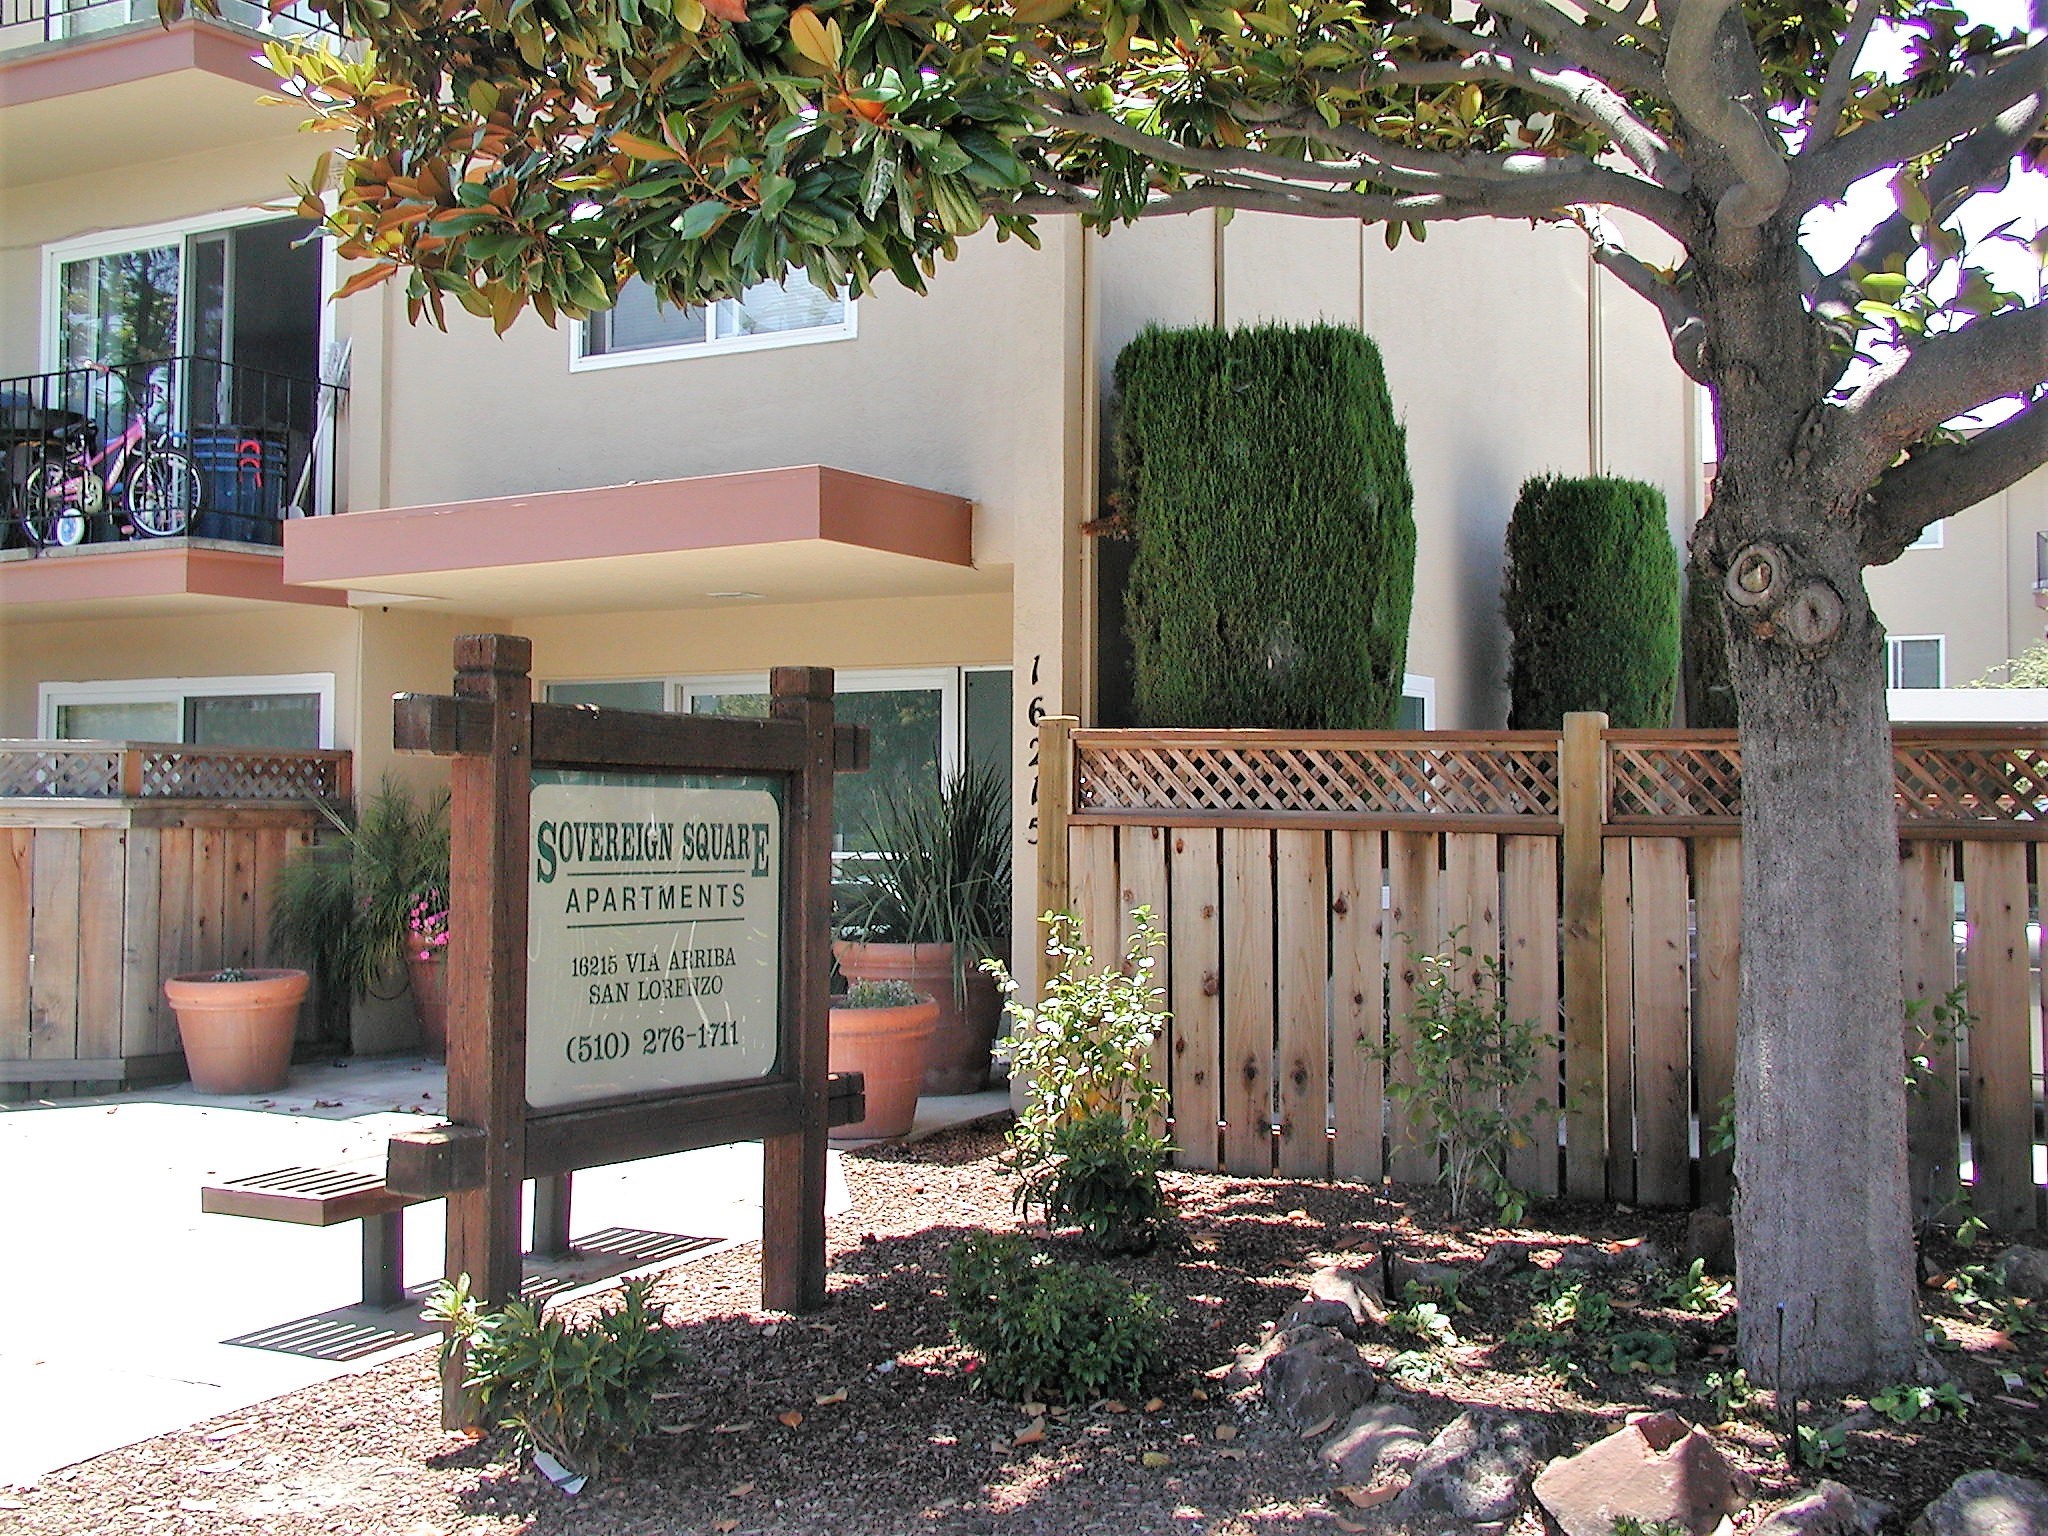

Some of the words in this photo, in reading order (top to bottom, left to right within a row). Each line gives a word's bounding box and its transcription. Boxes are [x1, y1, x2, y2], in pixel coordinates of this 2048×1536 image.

[537, 820, 673, 884] SOVEREIGN
[682, 822, 769, 877] SQUARE
[565, 883, 745, 914] APARTMENTS
[571, 954, 617, 977] 16215
[625, 951, 660, 973] VIA
[669, 947, 736, 970] ARRIBA
[589, 981, 629, 1005] SAN
[637, 974, 724, 1001] LORENZO
[566, 1031, 630, 1063] (510)
[642, 1020, 739, 1055] 276-1711
